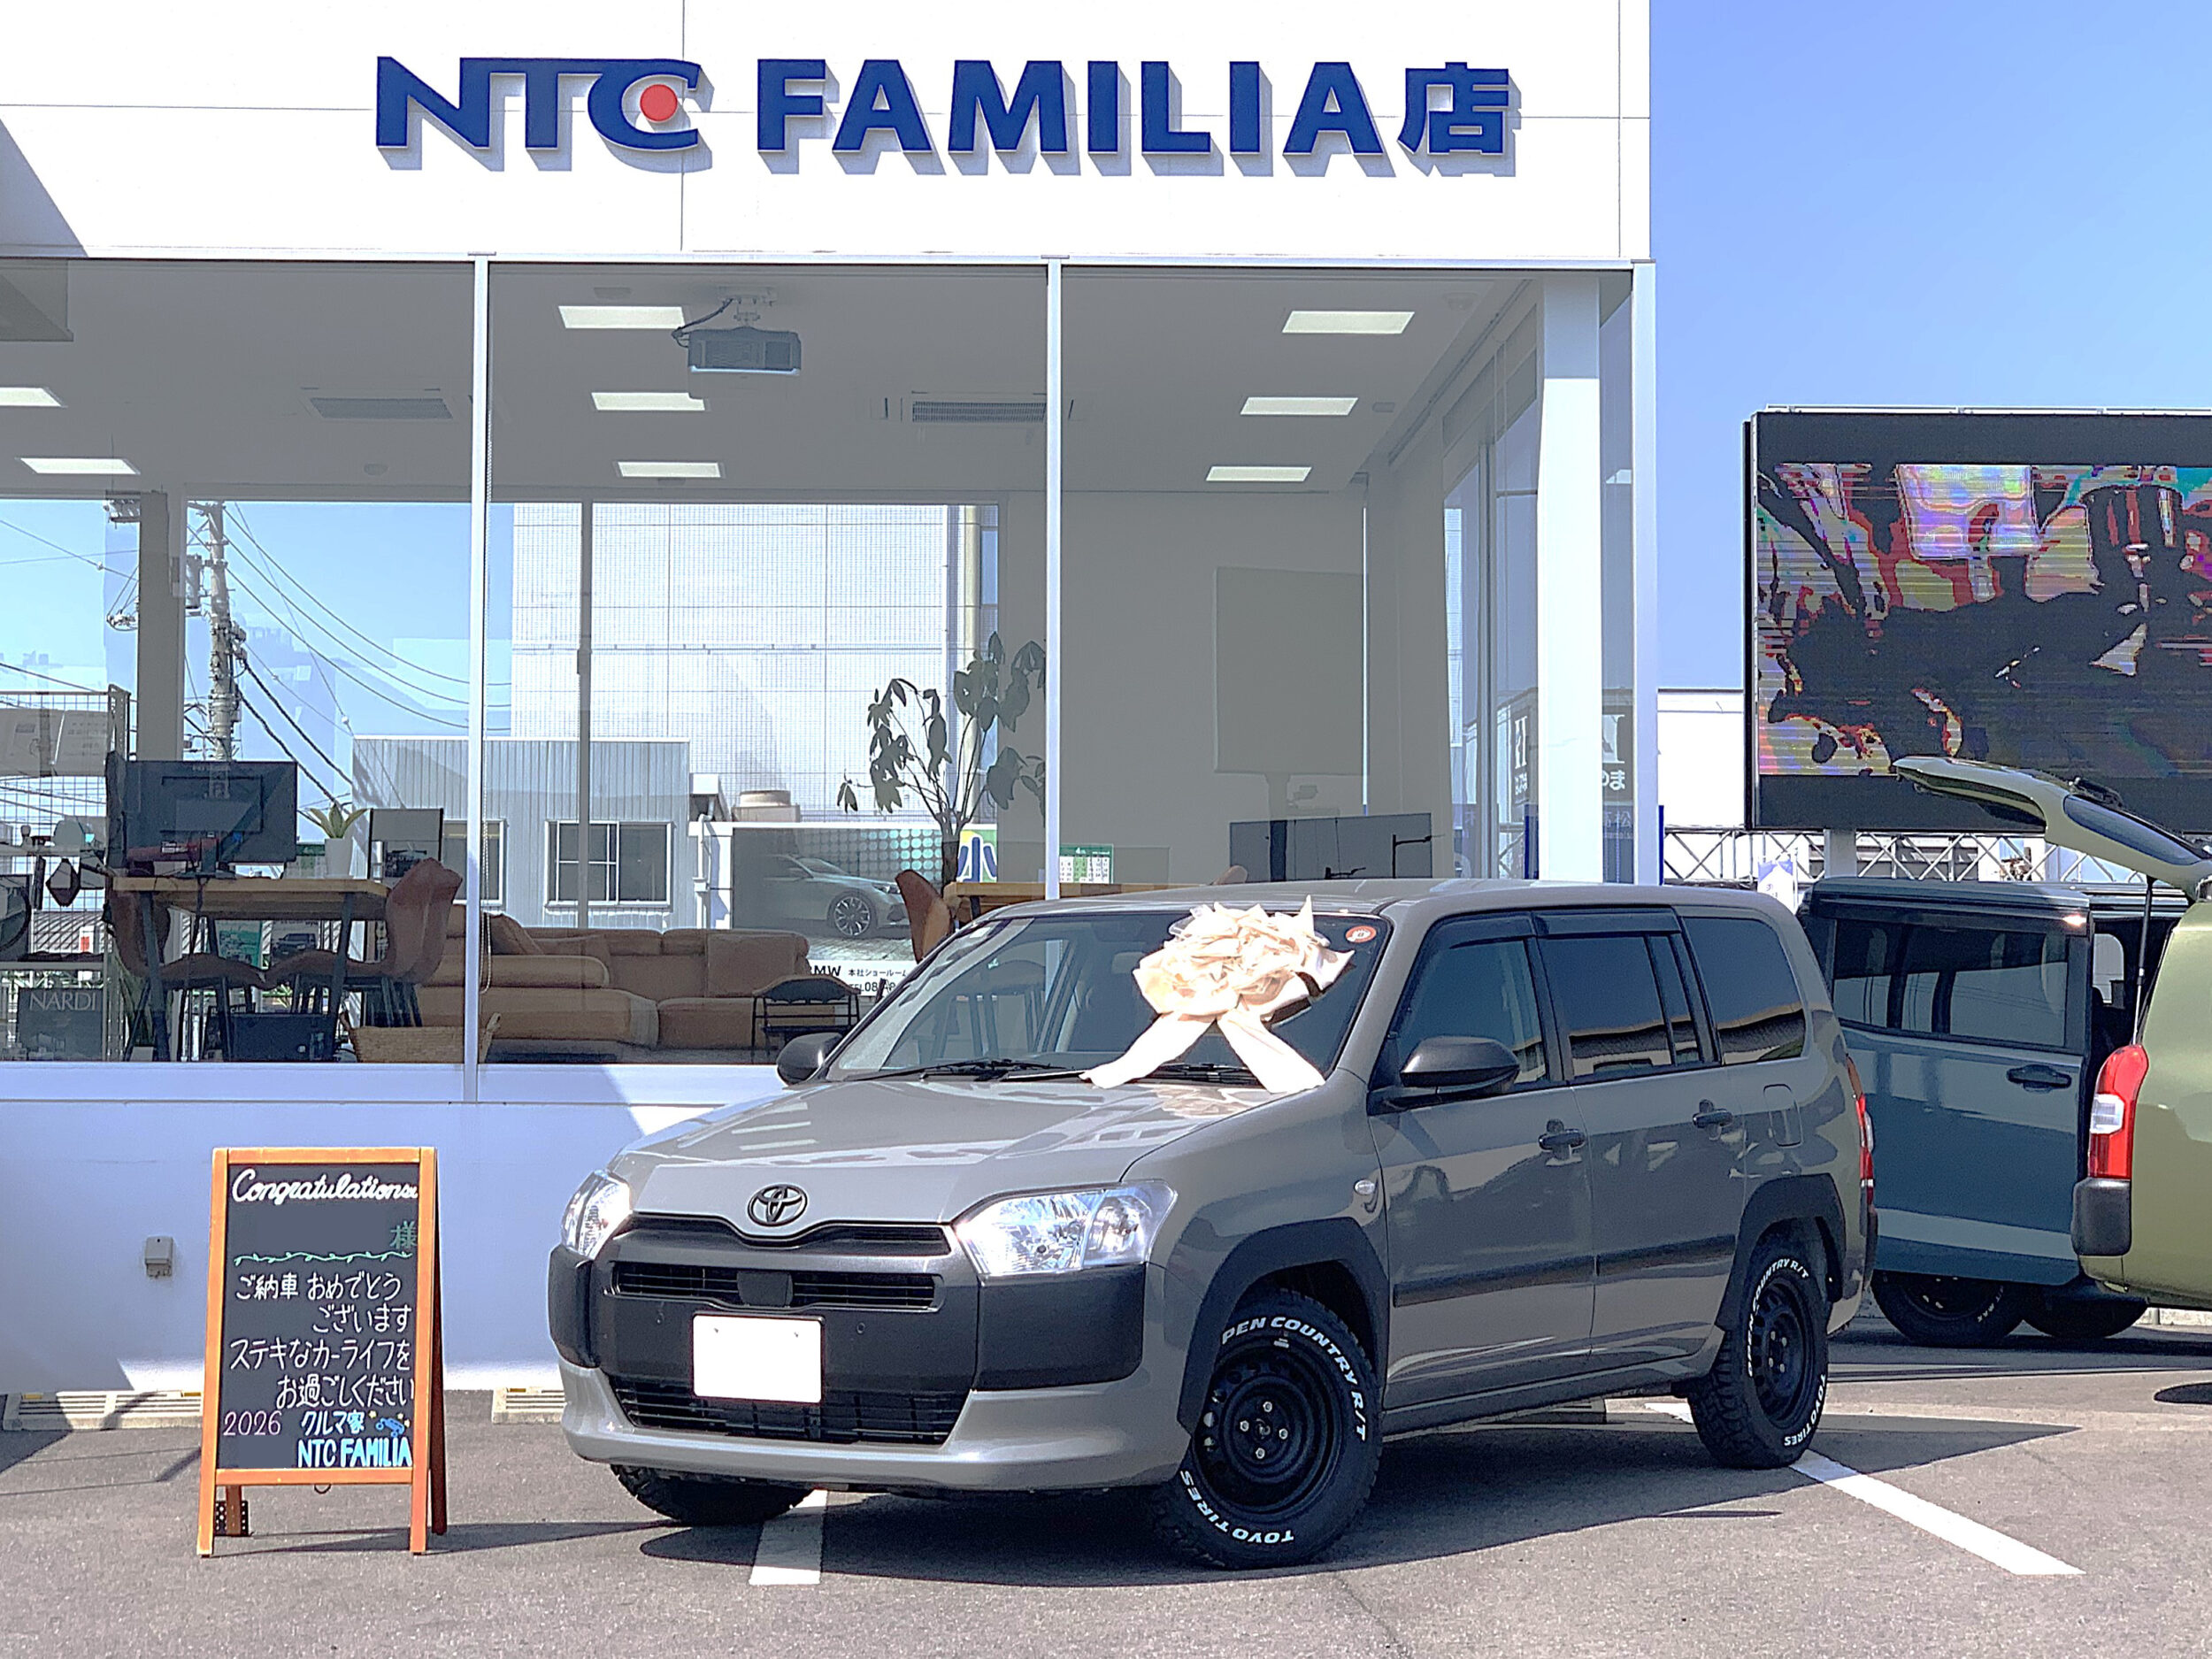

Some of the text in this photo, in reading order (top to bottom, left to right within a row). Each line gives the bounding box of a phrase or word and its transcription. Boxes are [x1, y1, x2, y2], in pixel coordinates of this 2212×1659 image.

[377, 57, 701, 150] NTC
[814, 965, 841, 976] MW
[30, 992, 96, 1010] NARDI
[390, 1220, 417, 1249] 様
[1790, 1261, 1809, 1278] R/T
[236, 1271, 401, 1302] ご納車 おめでとう
[313, 1302, 412, 1333] ございます
[230, 1337, 411, 1371] ステキなカーライフを
[276, 1373, 415, 1409] お過ごしください
[1221, 1317, 1366, 1441] PEN COUNTRY R/T
[223, 1411, 282, 1435] 2026
[301, 1409, 365, 1435] クルマ家
[1784, 1374, 1825, 1446] TOYO TIRES
[297, 1437, 412, 1467] NTC FAMILIA
[1179, 1470, 1294, 1544] TOYO TIRES
